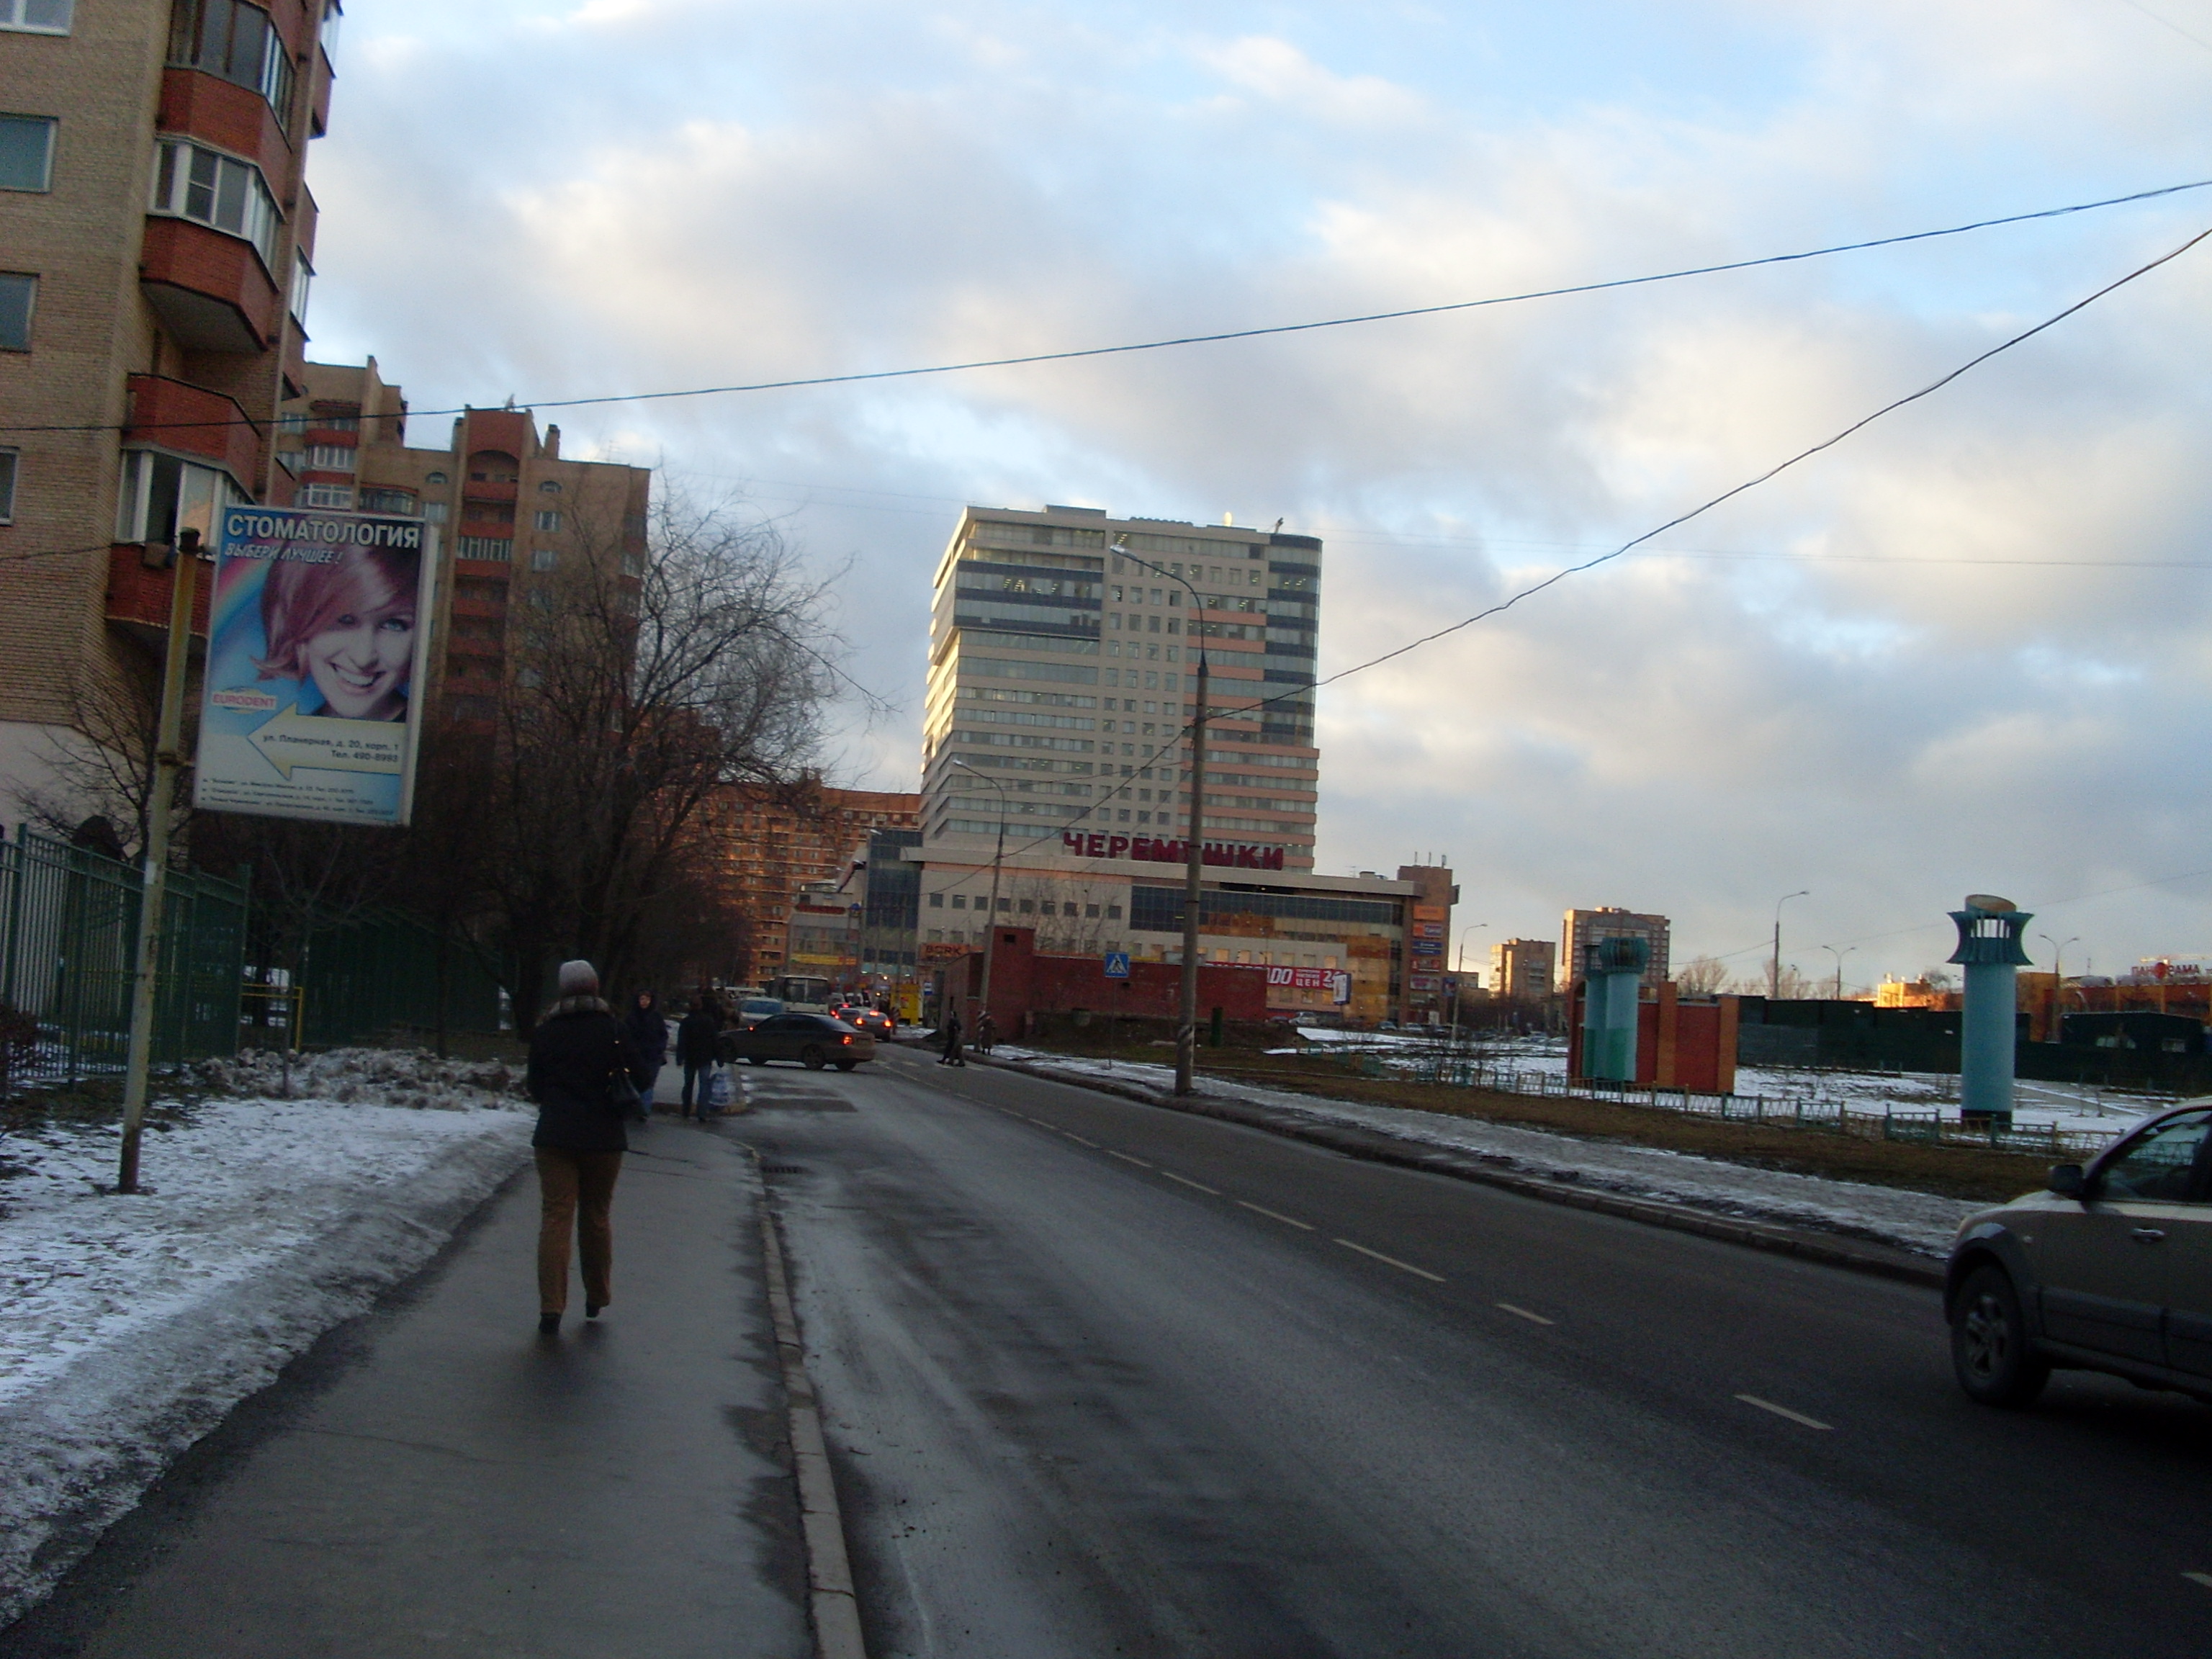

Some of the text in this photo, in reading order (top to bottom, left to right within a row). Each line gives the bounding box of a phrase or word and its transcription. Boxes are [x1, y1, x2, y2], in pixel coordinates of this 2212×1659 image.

[228, 514, 420, 548] СТОМАТОЛОГИЯ
[225, 542, 280, 559] ВЫБЕРИ
[213, 693, 276, 707] EURODENT
[926, 945, 961, 956] BORK
[1295, 978, 1320, 987] ЦЕН
